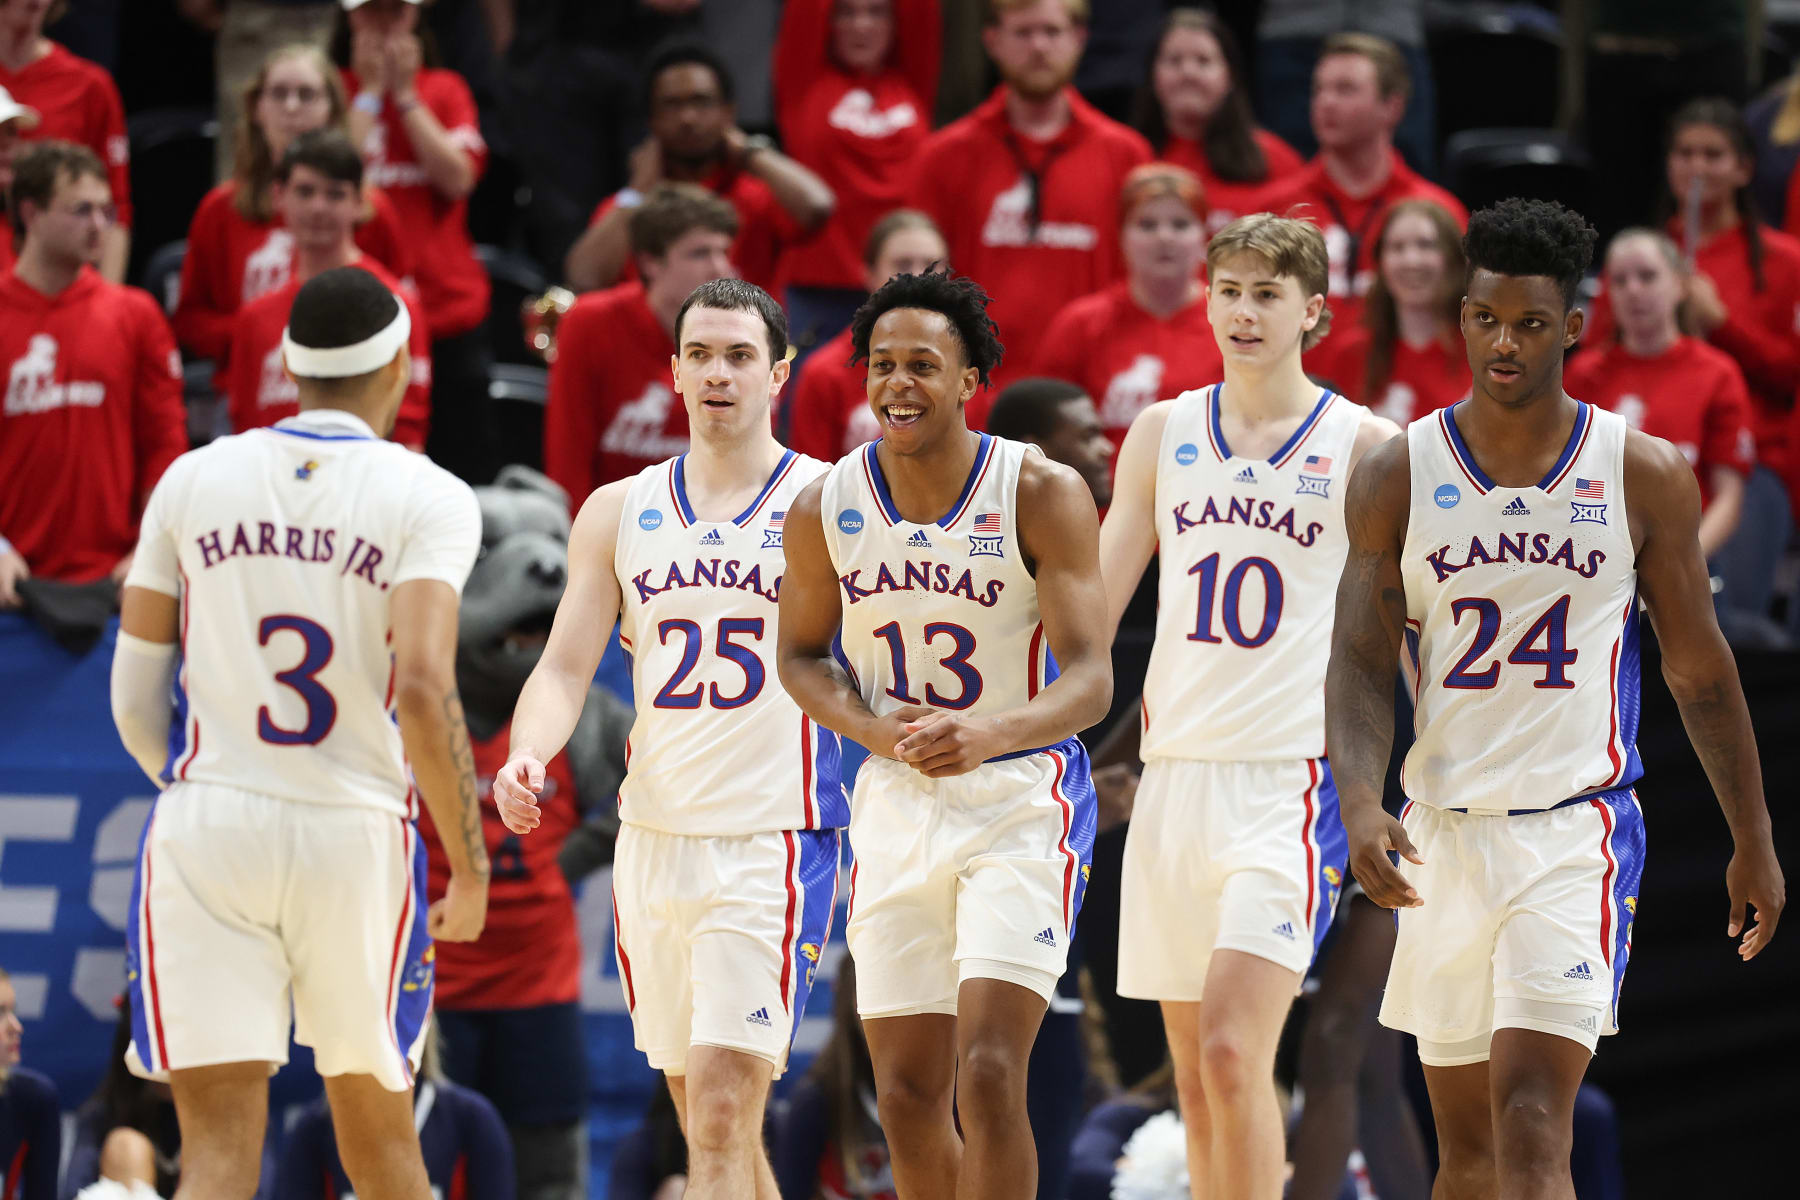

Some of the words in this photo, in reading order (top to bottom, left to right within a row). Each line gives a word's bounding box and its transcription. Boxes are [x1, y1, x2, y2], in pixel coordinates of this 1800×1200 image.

[1437, 495, 1458, 503] NCAA
[1501, 507, 1531, 516] adidas
[640, 518, 660, 526] NCAA
[841, 519, 862, 529] NCAA
[1172, 495, 1324, 548] KANSAS
[196, 521, 336, 570] HARRIS
[340, 537, 390, 591] JR.
[698, 537, 725, 546] adidas
[906, 539, 932, 548] adidas
[1425, 532, 1607, 584] KANSAS
[839, 560, 1005, 608] KANSAS
[1186, 552, 1284, 649] 10
[1442, 594, 1579, 690] 24
[653, 616, 766, 710] 25
[872, 620, 984, 711] 13
[258, 614, 338, 747] 3
[1033, 935, 1057, 948] adidas
[1563, 971, 1594, 981] adidas
[745, 1016, 772, 1027] adidas
